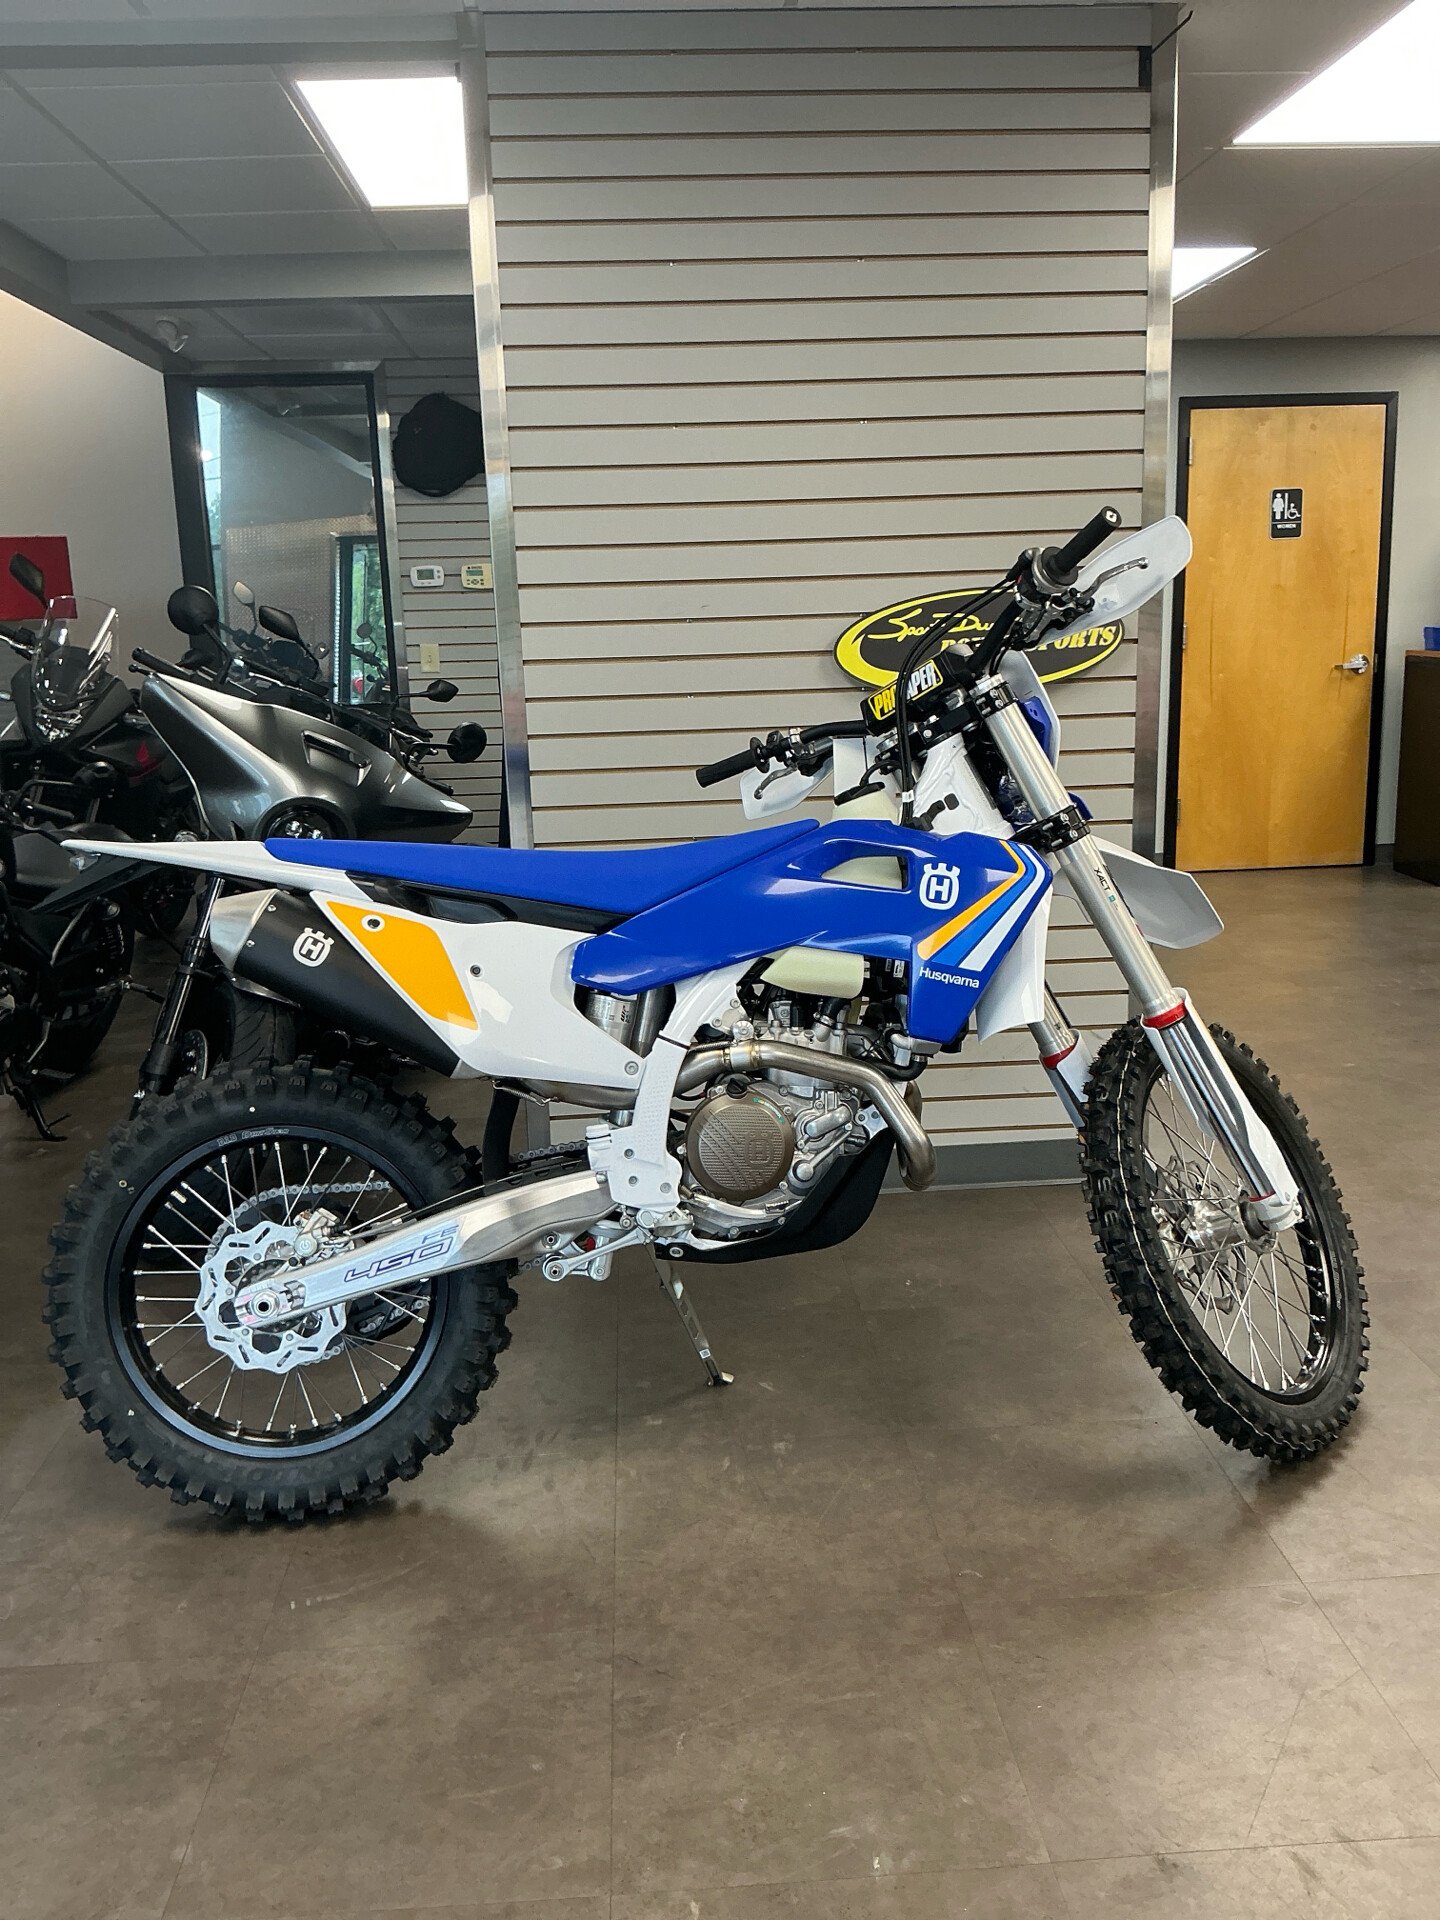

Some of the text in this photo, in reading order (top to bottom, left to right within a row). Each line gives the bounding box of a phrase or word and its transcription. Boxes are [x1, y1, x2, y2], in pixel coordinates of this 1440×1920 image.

[919, 967, 980, 988] Husqvarna
[422, 1224, 459, 1244] FE
[344, 1236, 454, 1282] 450
